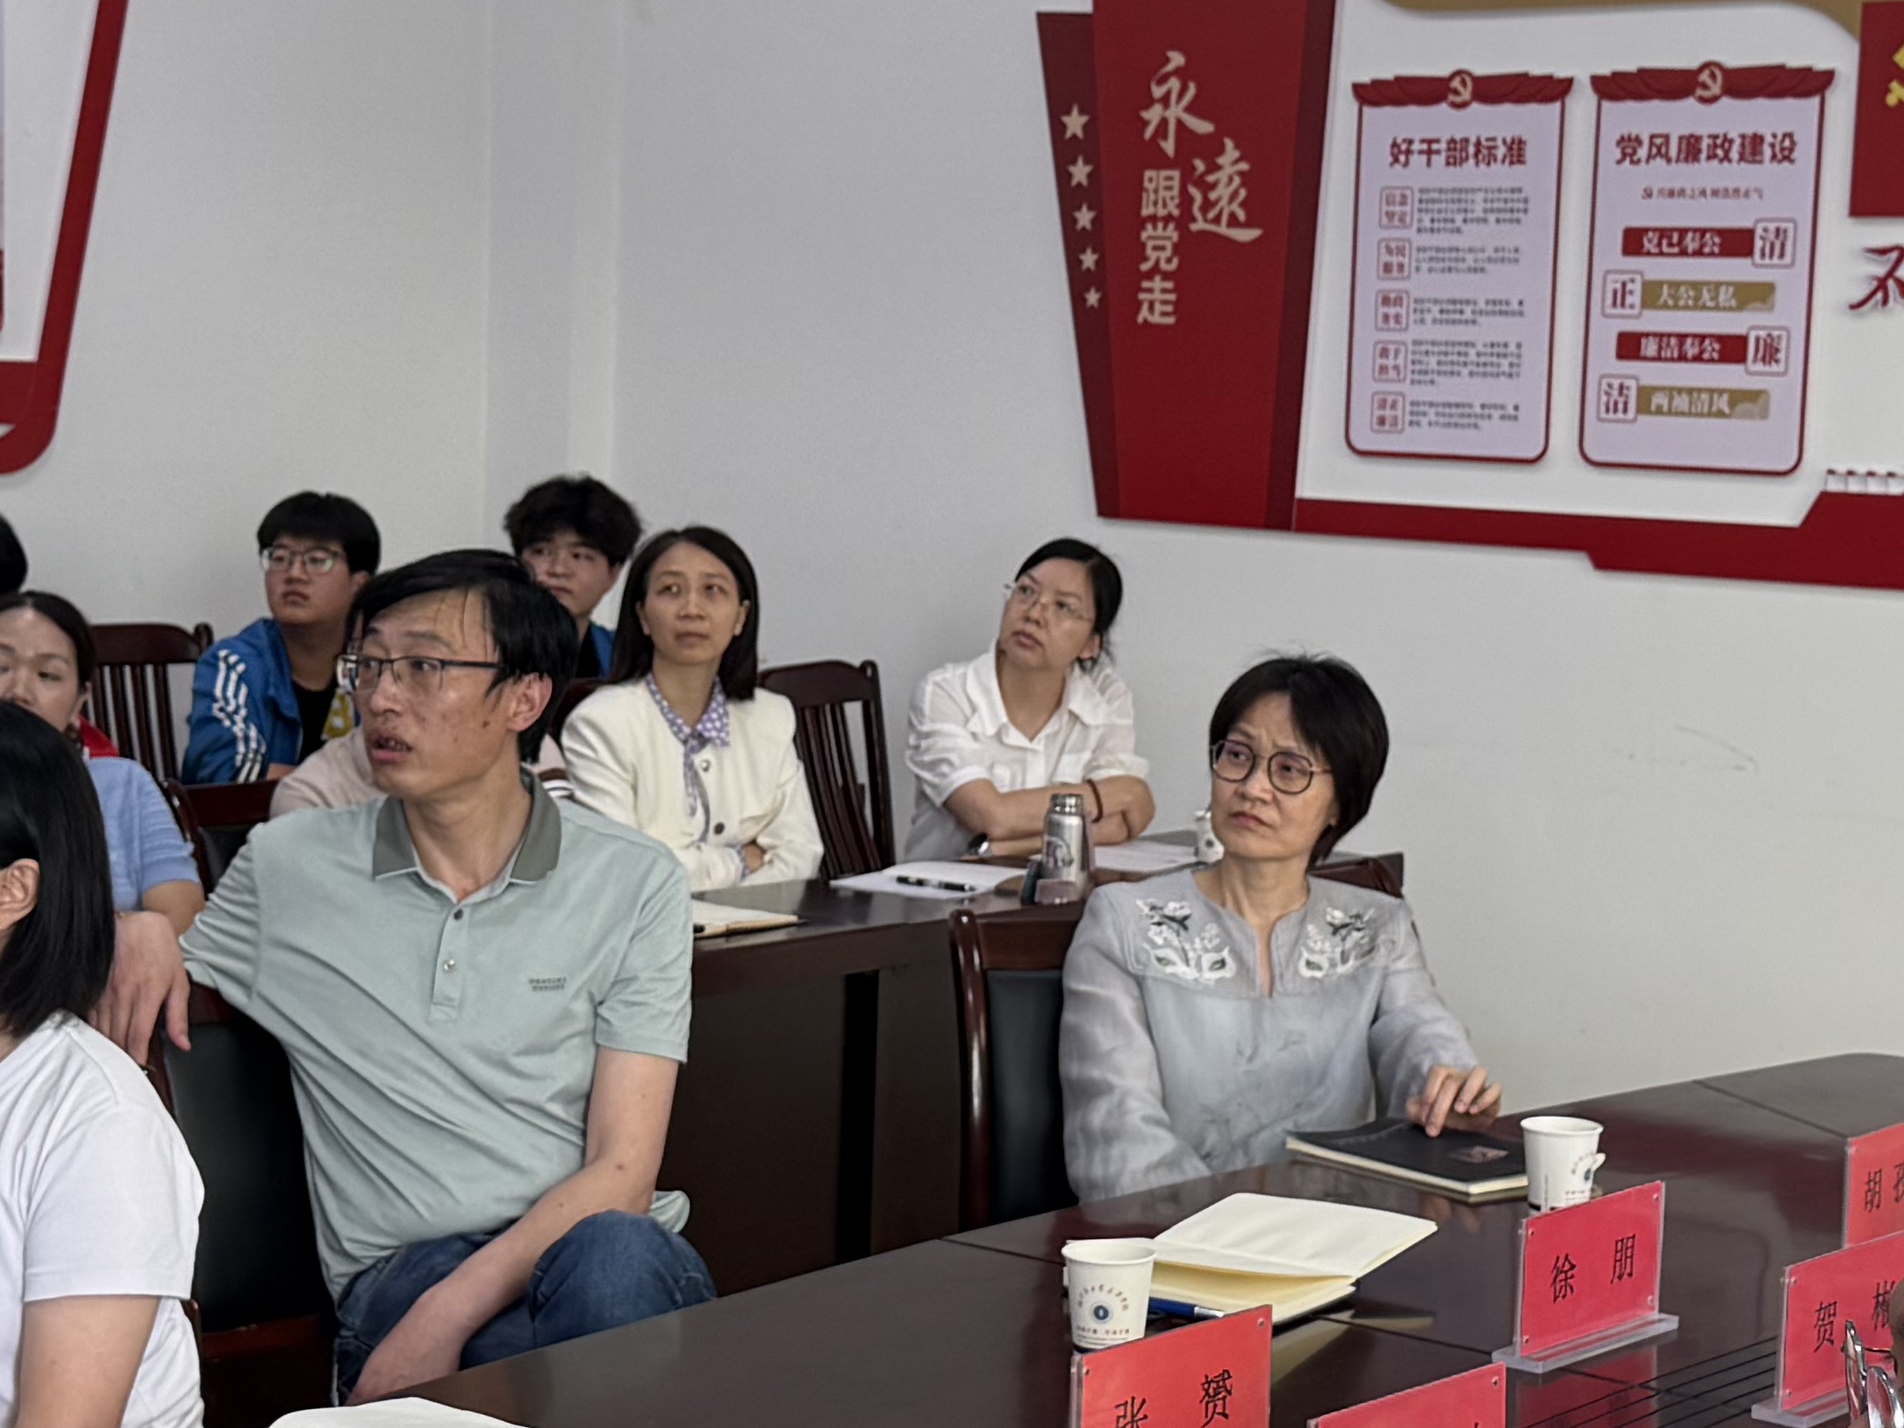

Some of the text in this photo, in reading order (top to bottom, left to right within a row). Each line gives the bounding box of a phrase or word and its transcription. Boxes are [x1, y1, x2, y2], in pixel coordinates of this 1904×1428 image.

[1390, 137, 1526, 167] 好干部标准
[1617, 133, 1796, 164] 党风廉政建设
[1138, 170, 1179, 323] 跟党走
[1643, 227, 1787, 259] 克己奉公 清
[1612, 279, 1736, 308] 正 大公无私
[1640, 334, 1779, 364] 廉洁奉公 廉
[1551, 1234, 1635, 1303] 徐朋
